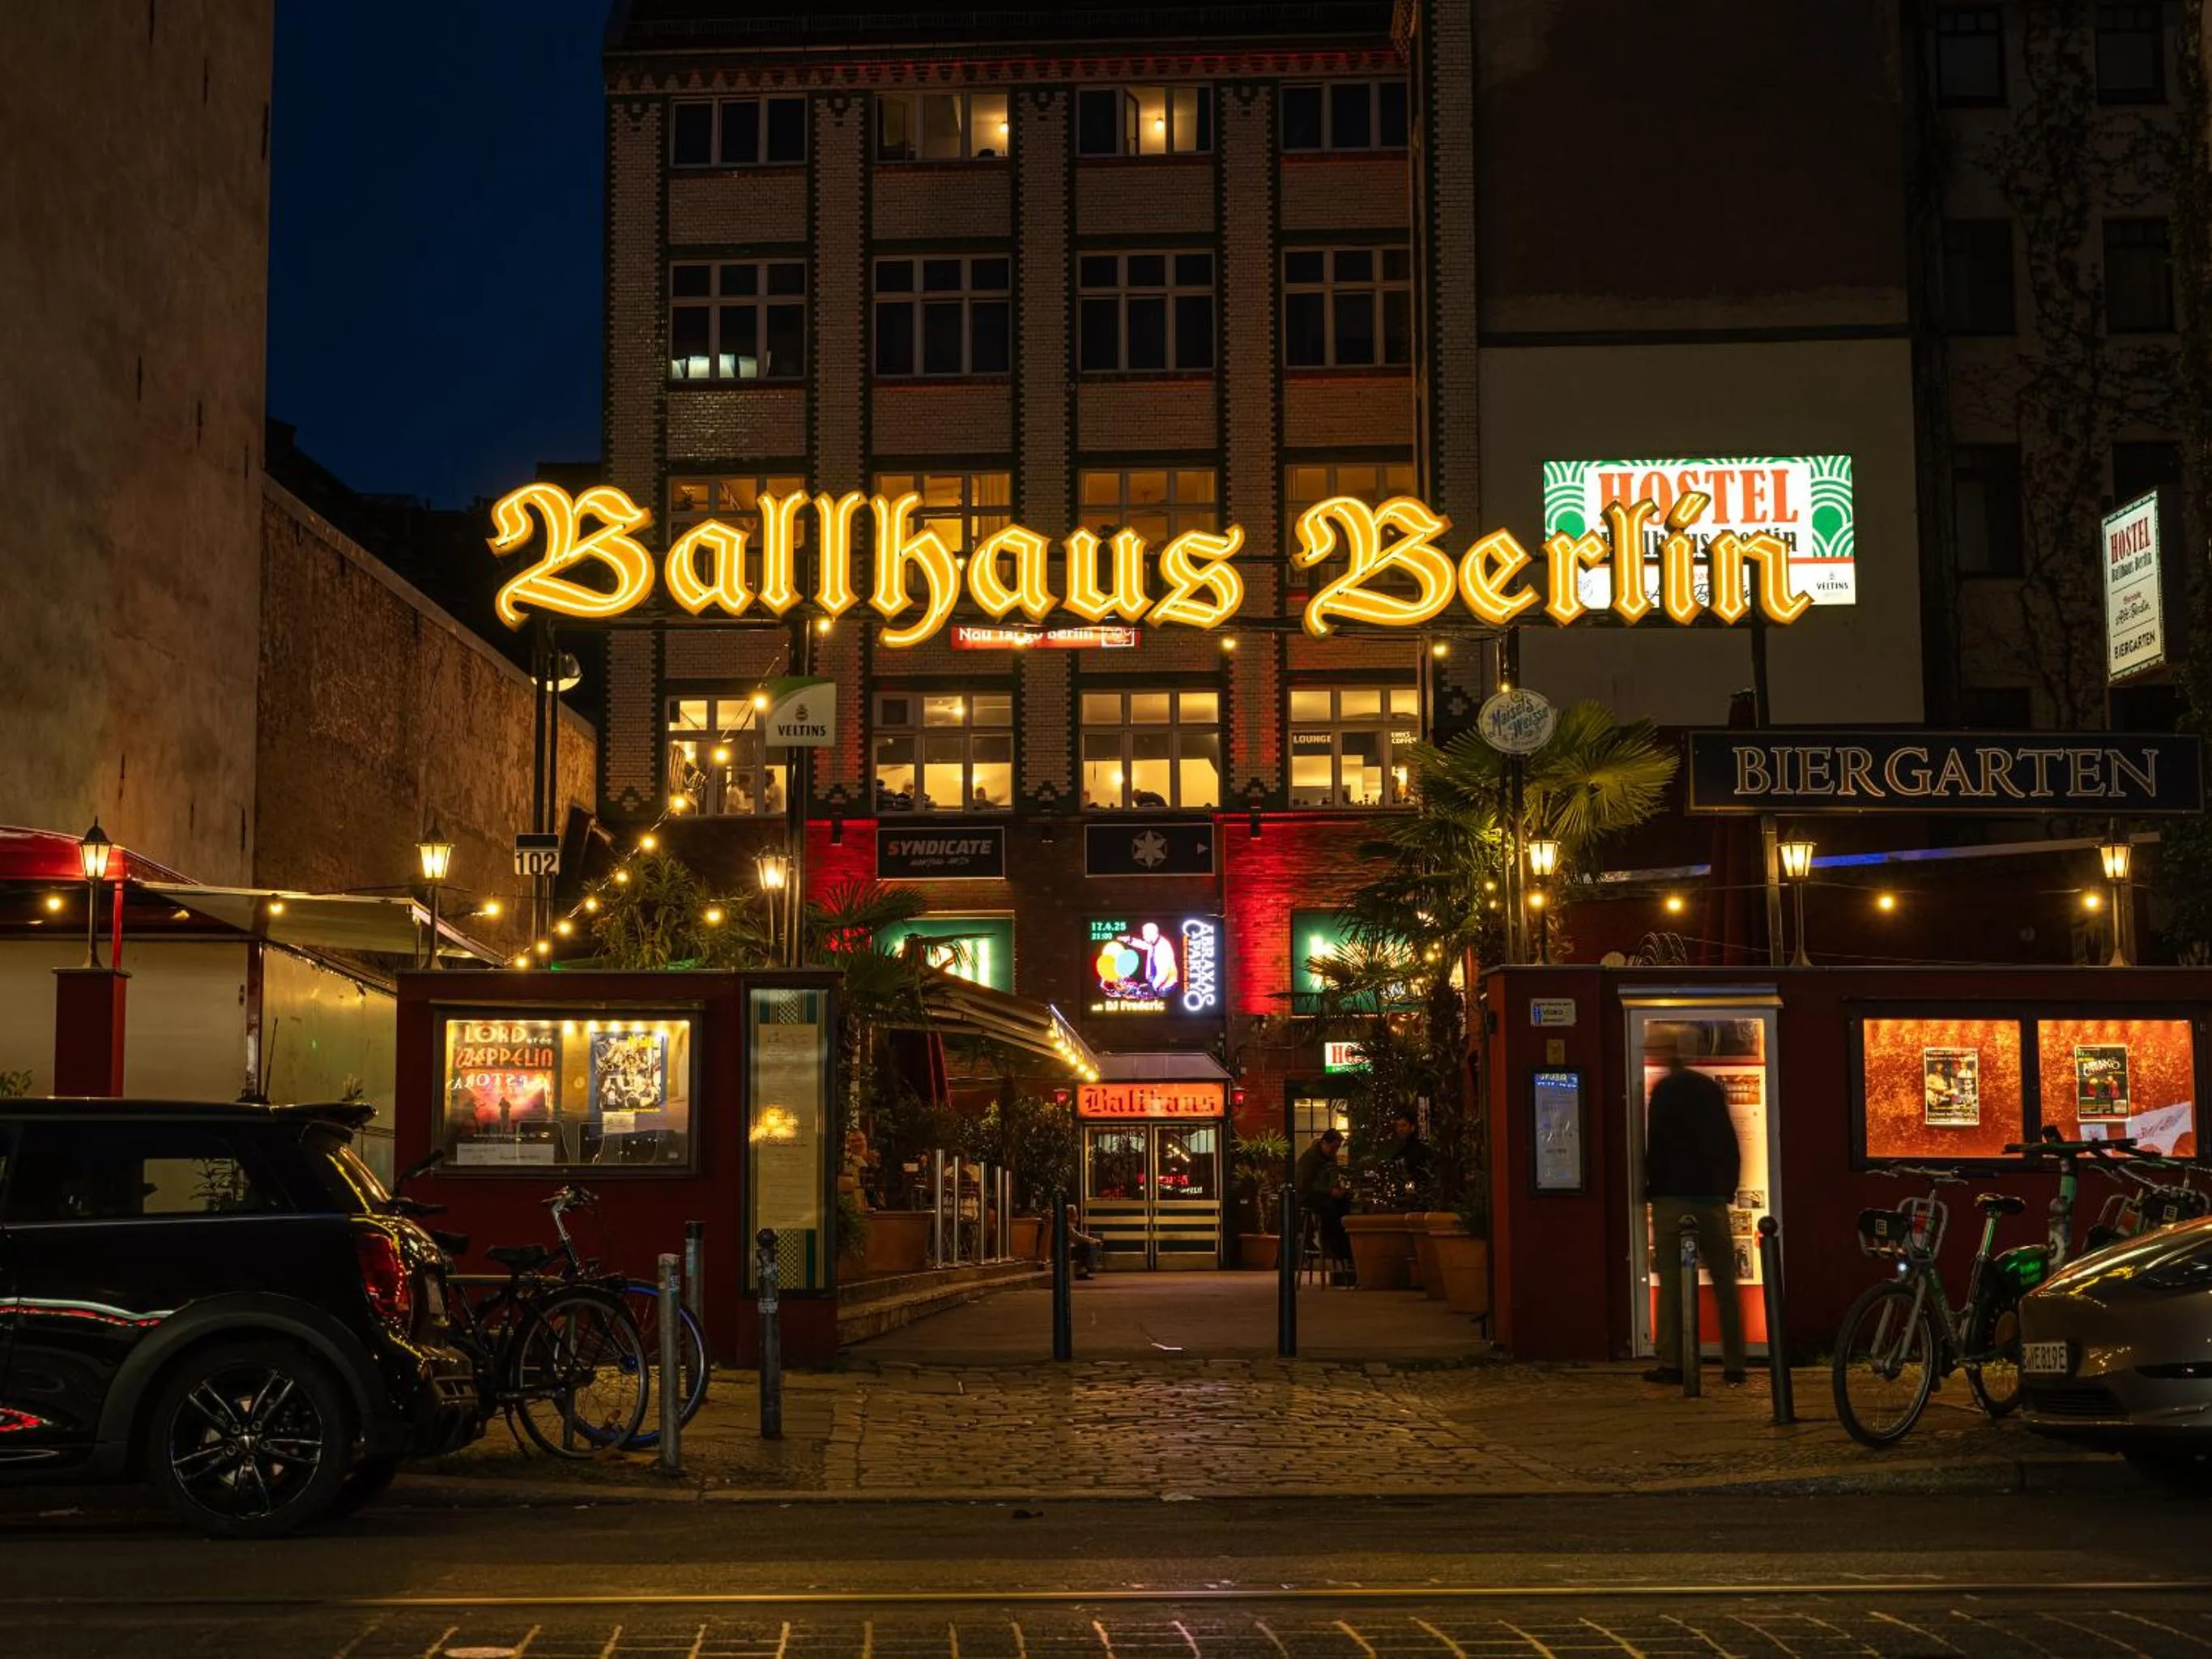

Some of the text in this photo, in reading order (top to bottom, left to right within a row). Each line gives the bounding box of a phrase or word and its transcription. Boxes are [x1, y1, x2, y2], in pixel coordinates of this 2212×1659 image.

[2111, 517, 2151, 564] HOSTEL
[486, 482, 1814, 647] Ballhaus Berlin
[1817, 582, 1848, 591] VELTINS
[2114, 629, 2156, 659] BIERGARTEN
[778, 724, 826, 736] VELTINS
[1294, 735, 1332, 744] LOUNGE
[1733, 746, 2159, 798] BIERGARTEN
[887, 839, 992, 856] SYNDICATE
[515, 852, 557, 876] 102
[1183, 919, 1216, 1012] ABRAXAS
[1188, 940, 1201, 992] PARTY
[464, 1025, 528, 1043] LORD
